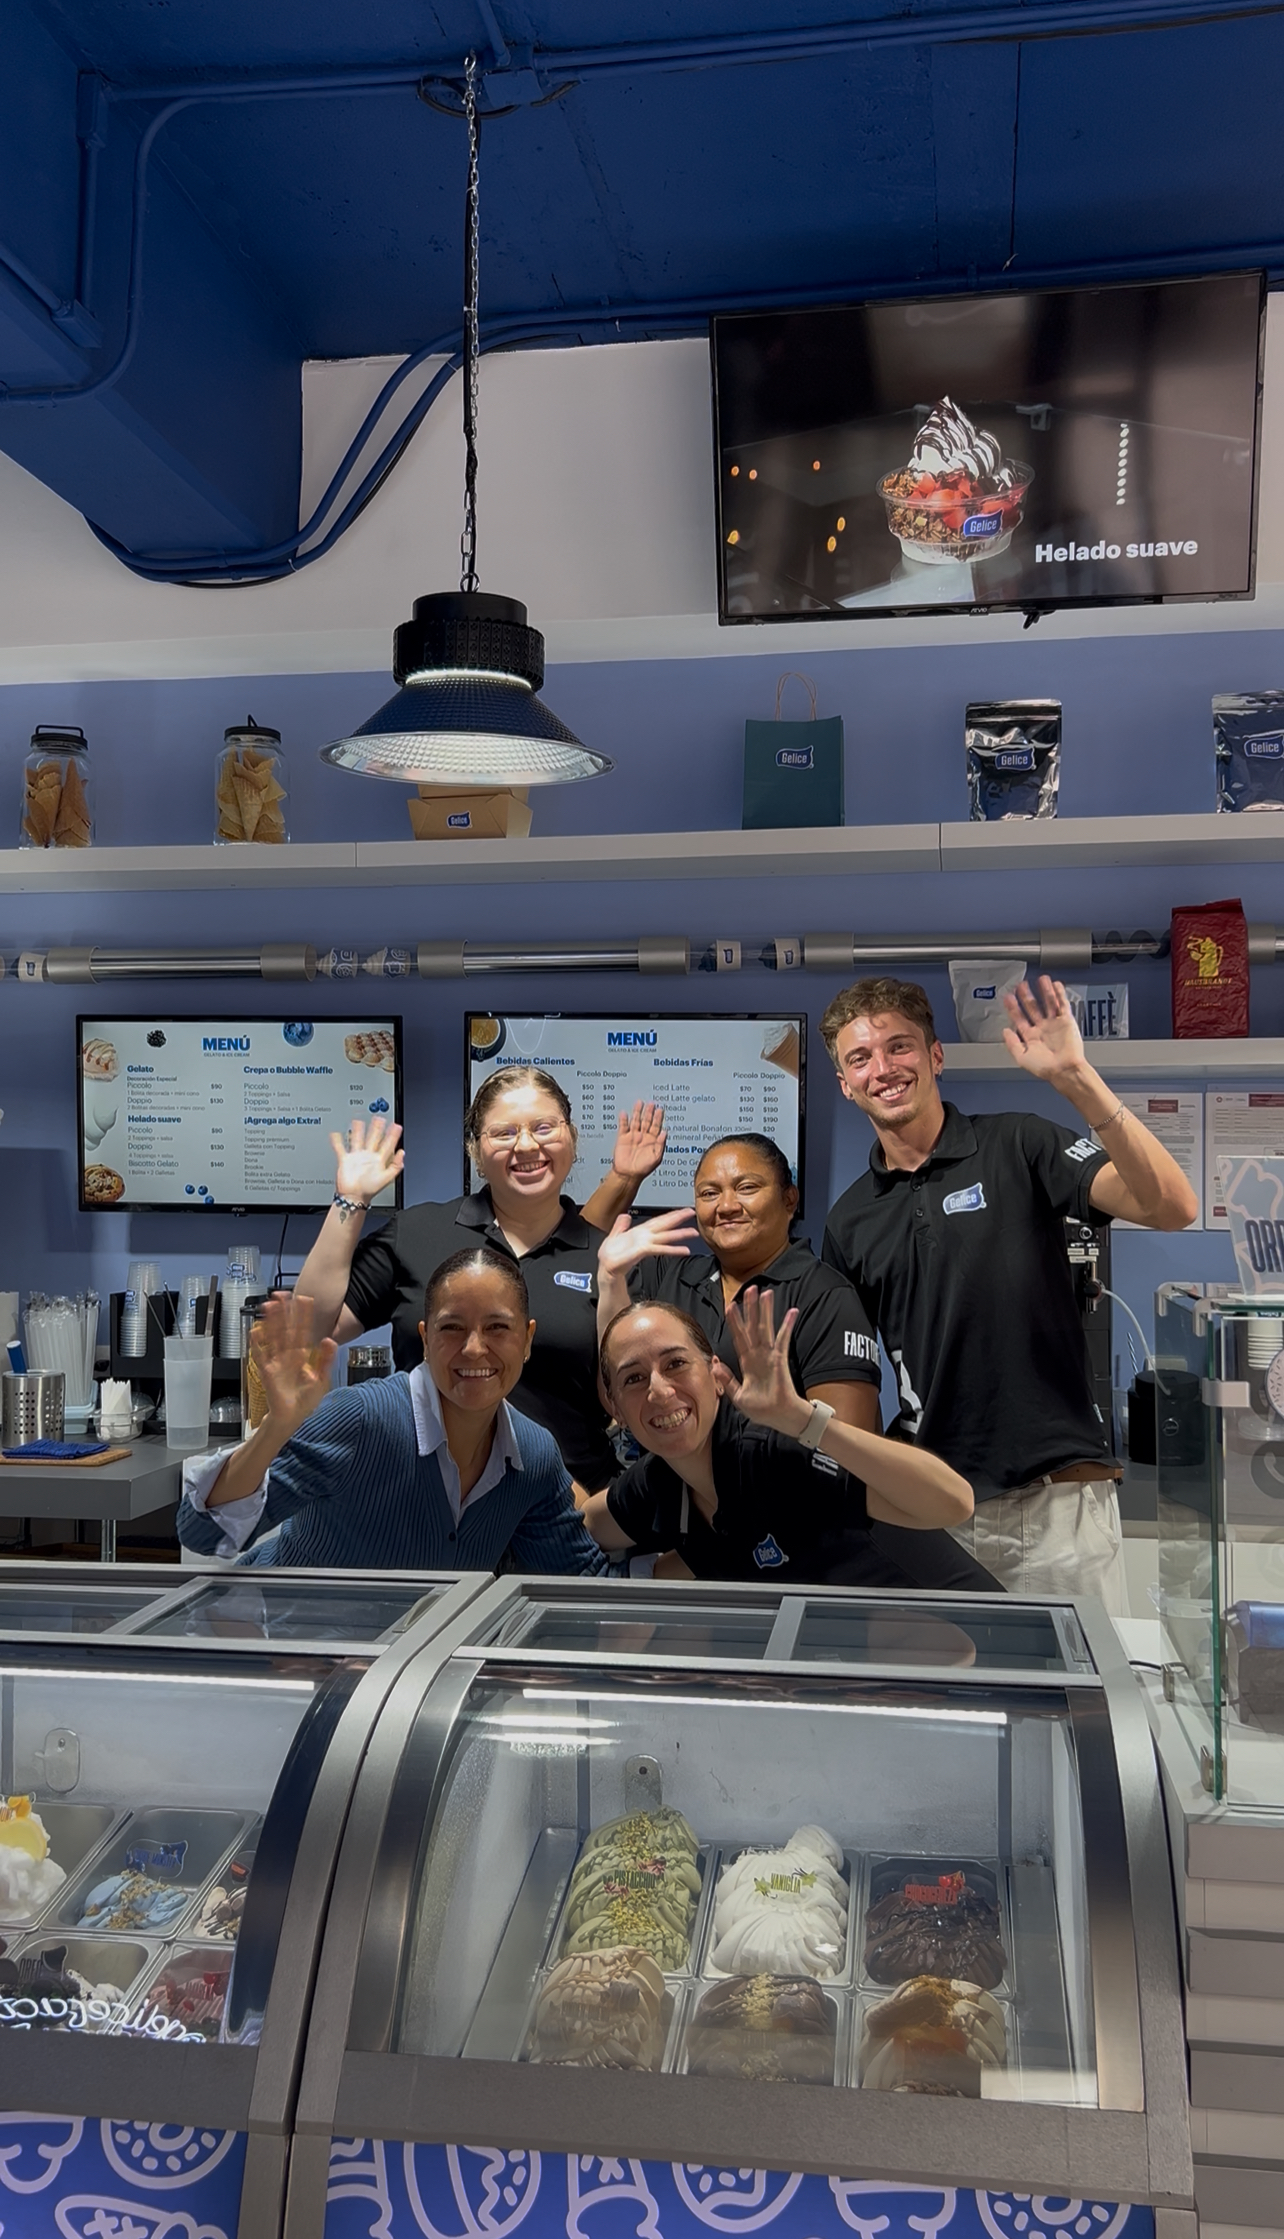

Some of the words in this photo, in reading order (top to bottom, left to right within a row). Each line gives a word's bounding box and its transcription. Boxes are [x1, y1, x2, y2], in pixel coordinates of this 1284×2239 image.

[970, 519, 997, 533] Gelice
[1036, 540, 1121, 562] Helado
[1126, 540, 1198, 558] suave
[1250, 742, 1280, 754] Gelice
[782, 752, 808, 764] Gelice
[1001, 754, 1028, 766] Gelice
[202, 1034, 250, 1051] MENÚ
[608, 1029, 657, 1046] MENÚ
[496, 1057, 531, 1065] Bebidas
[533, 1057, 575, 1065] Calientes
[691, 1059, 714, 1067] Frías
[127, 1065, 154, 1073] Gelato
[244, 1066, 268, 1074] Crepa
[692, 1095, 715, 1103] gelato
[244, 1117, 277, 1125] ¡Agrega
[278, 1117, 296, 1125] algo
[950, 1193, 977, 1209] Gelice
[614, 1870, 657, 1889] PISTACCHIO
[770, 1873, 800, 1893] VANIGLIA
